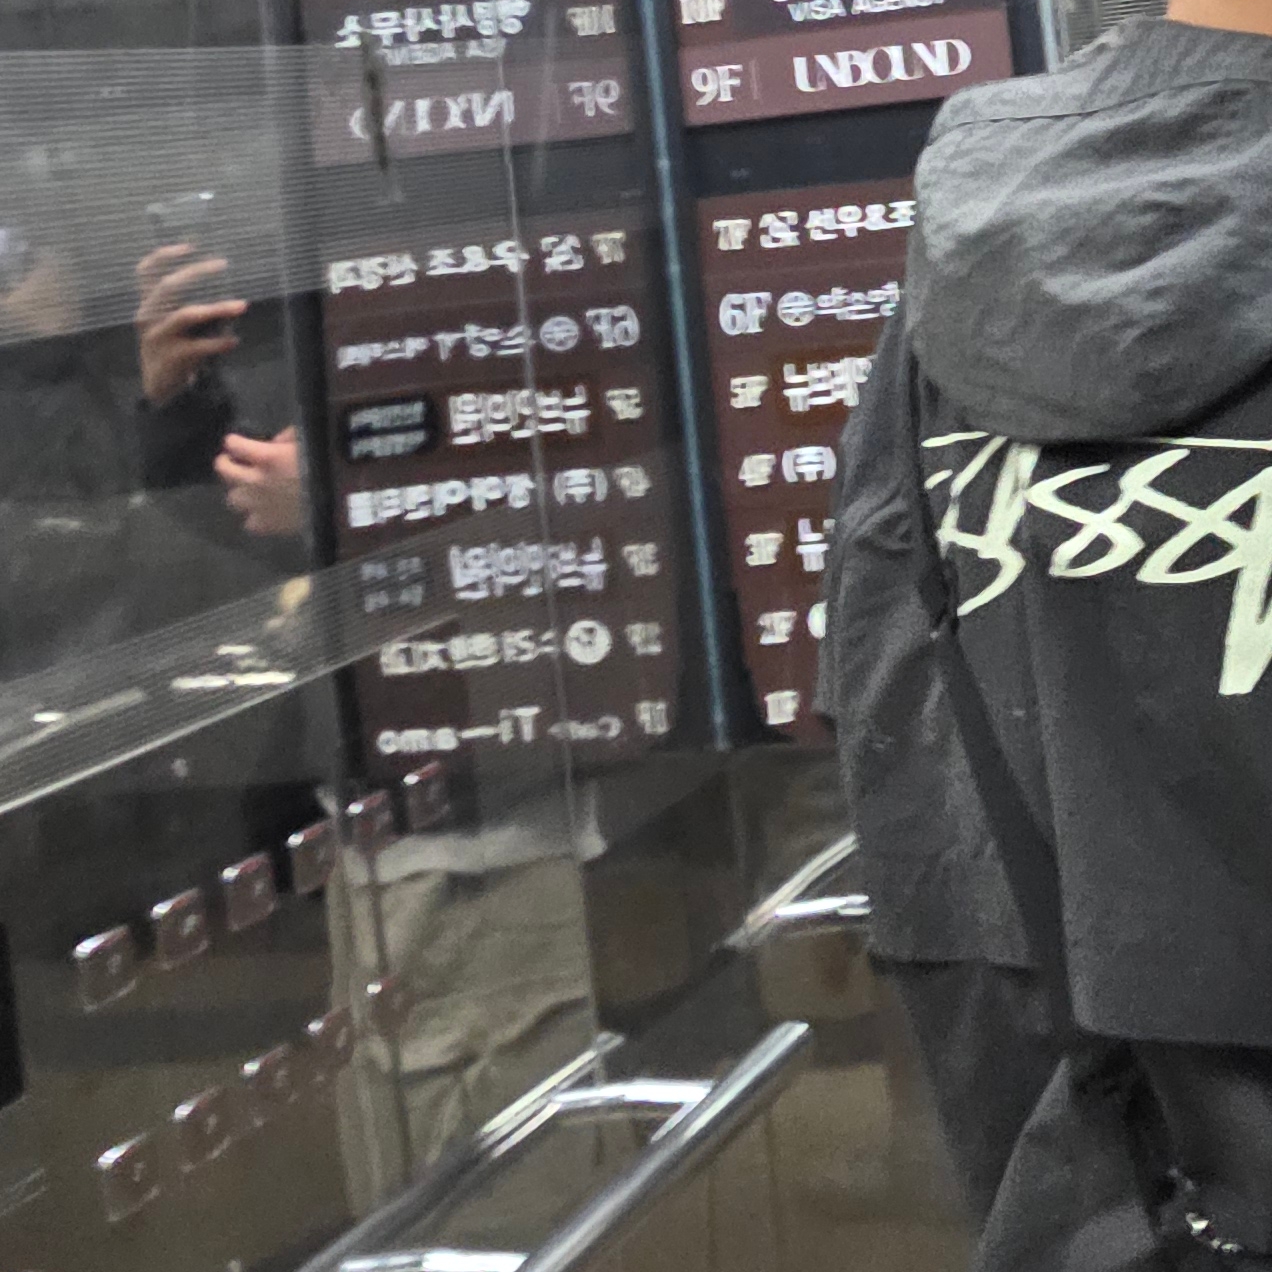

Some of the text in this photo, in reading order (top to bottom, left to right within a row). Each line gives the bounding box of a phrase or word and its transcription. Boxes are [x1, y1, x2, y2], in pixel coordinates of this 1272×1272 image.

[691, 39, 973, 106] 9F UNBOUND
[719, 291, 772, 335] 6F
[796, 518, 836, 572] 뉴
